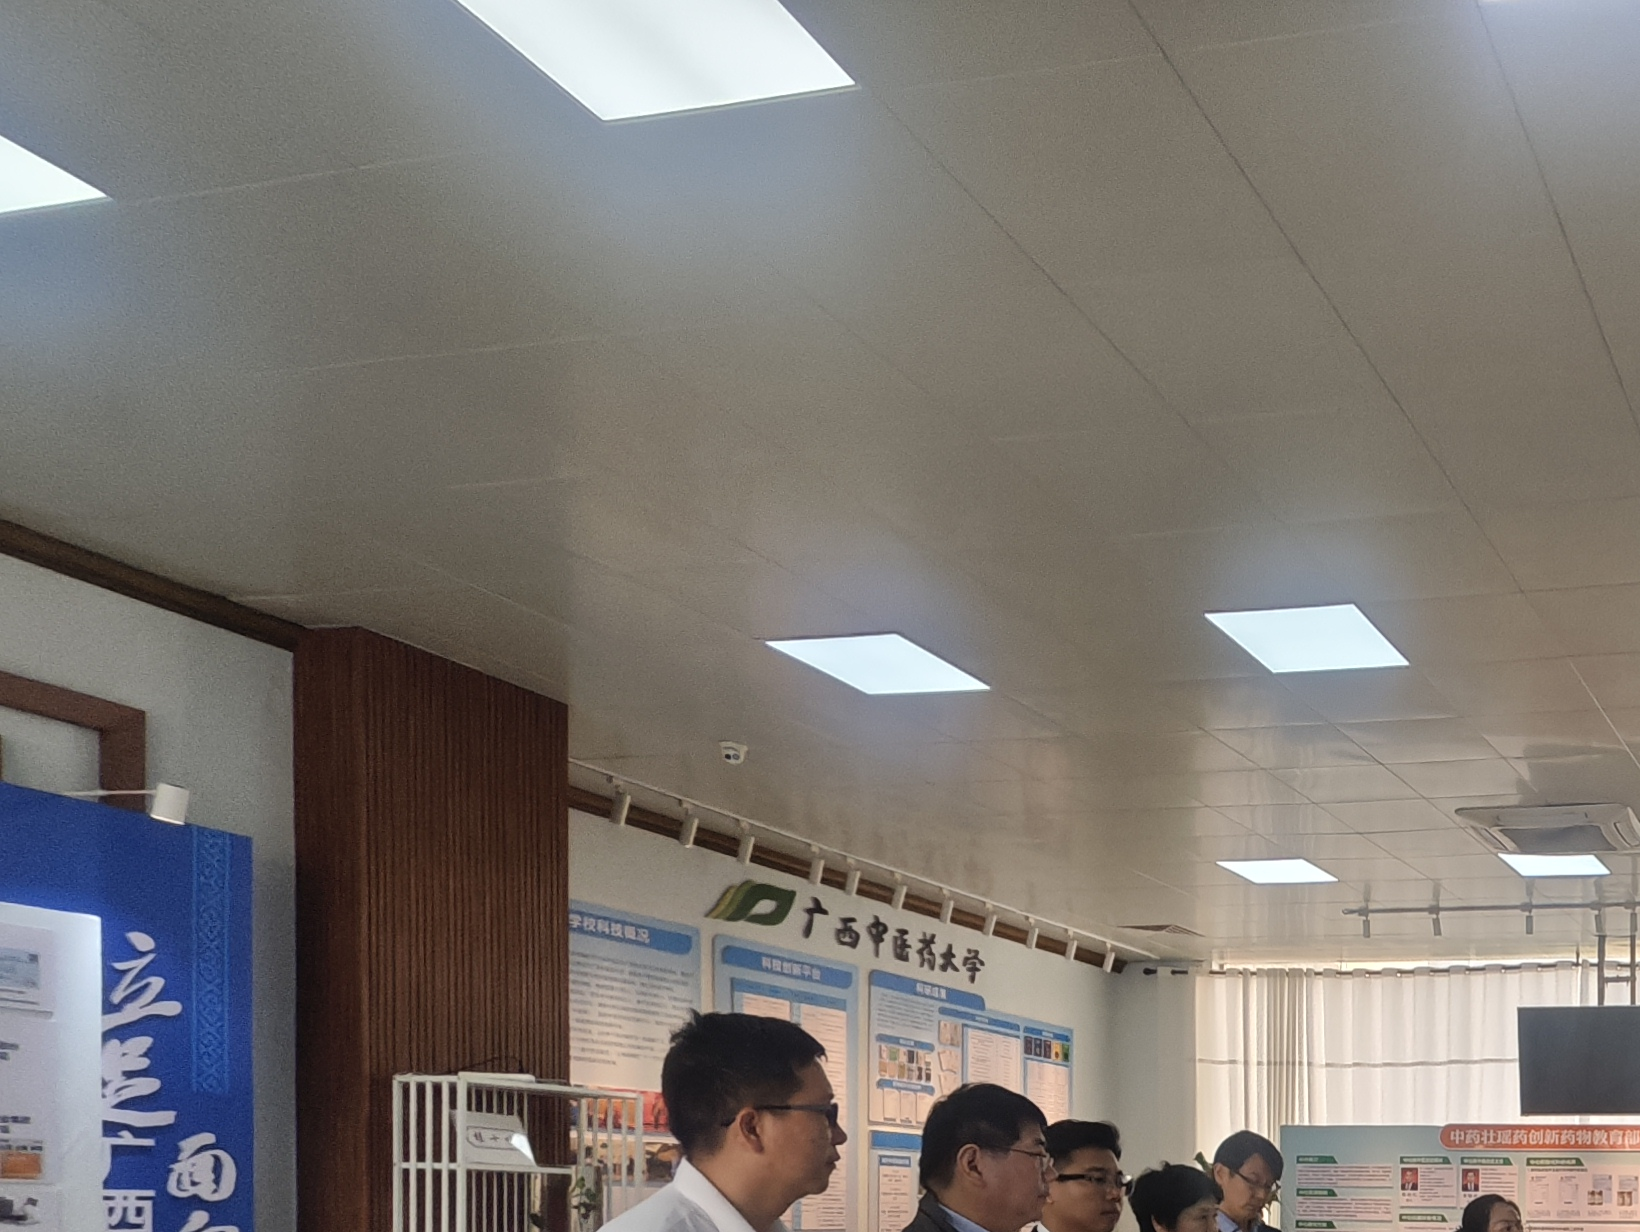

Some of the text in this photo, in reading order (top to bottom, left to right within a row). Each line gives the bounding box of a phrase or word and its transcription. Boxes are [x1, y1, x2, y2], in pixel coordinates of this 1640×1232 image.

[802, 896, 986, 985] 广西中医药大学
